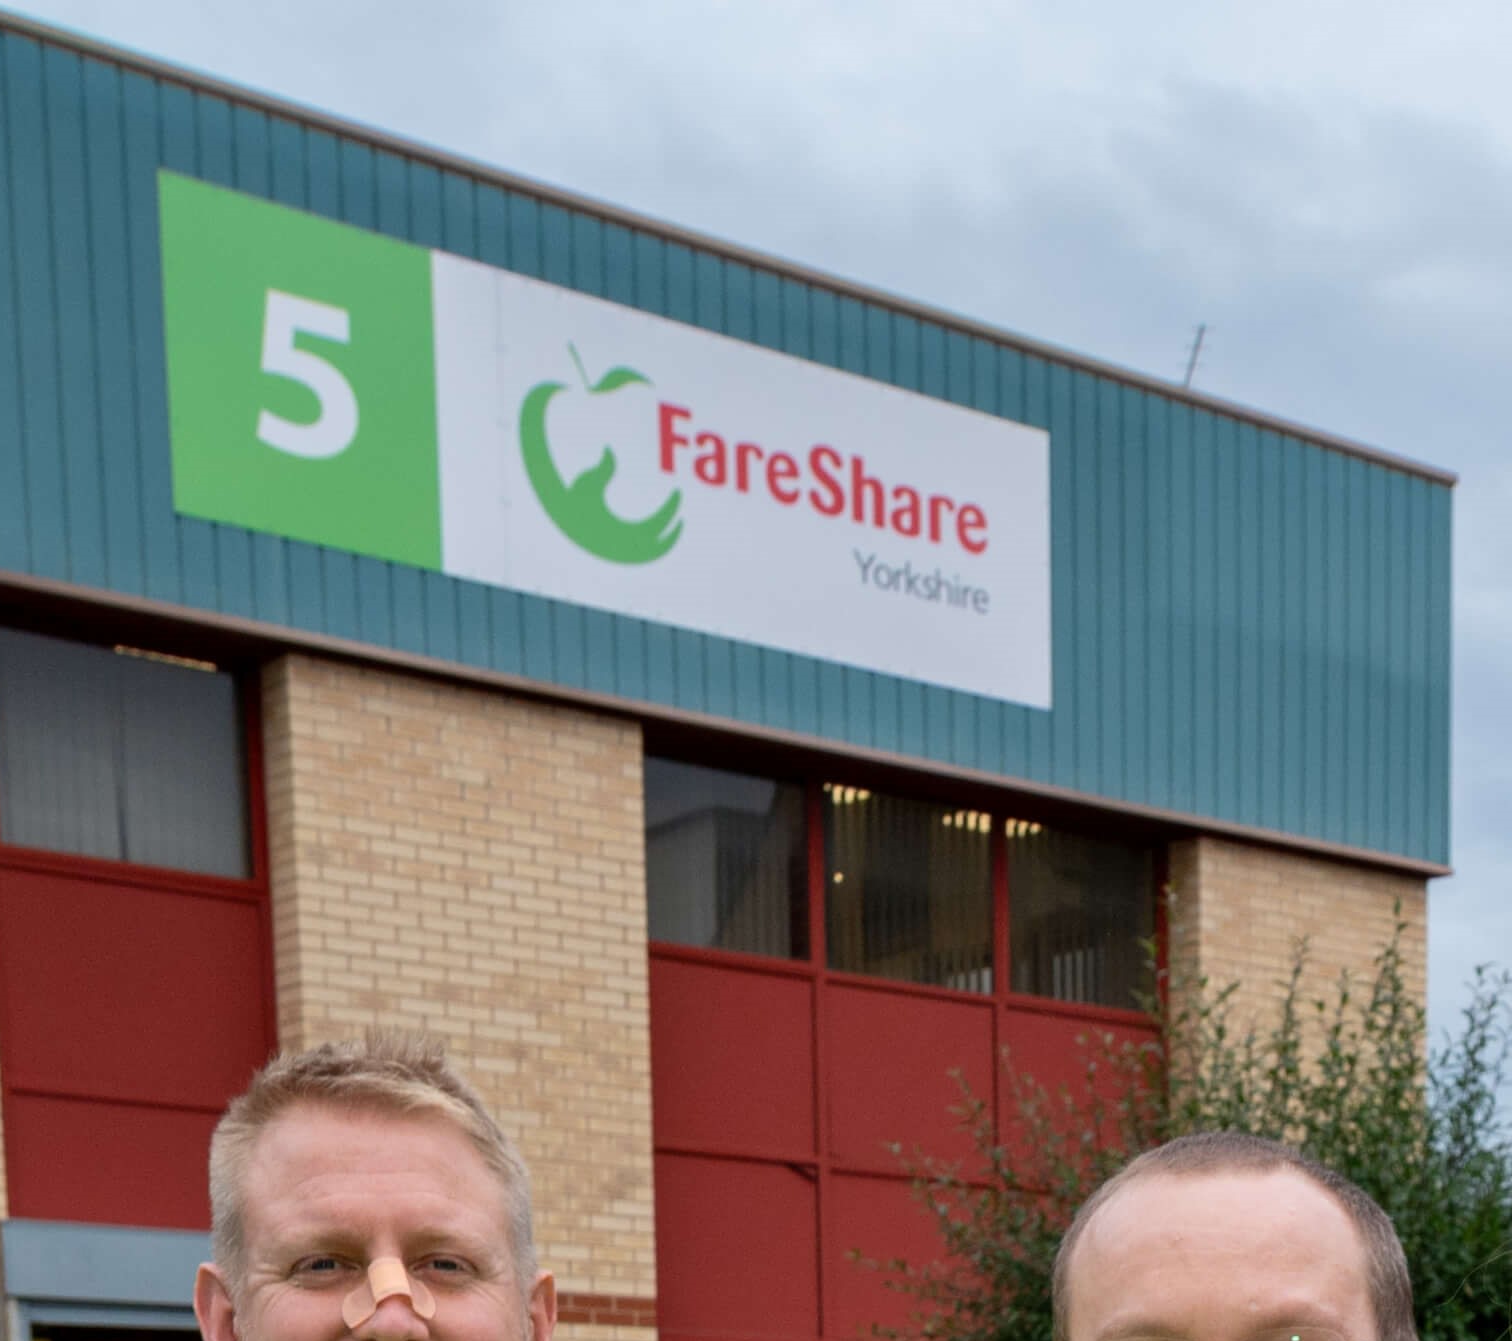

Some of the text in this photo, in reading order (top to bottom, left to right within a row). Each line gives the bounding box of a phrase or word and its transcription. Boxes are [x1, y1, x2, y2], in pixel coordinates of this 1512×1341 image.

[256, 288, 360, 459] 5
[657, 402, 989, 556] FareShare
[852, 548, 990, 616] Yorkshire
